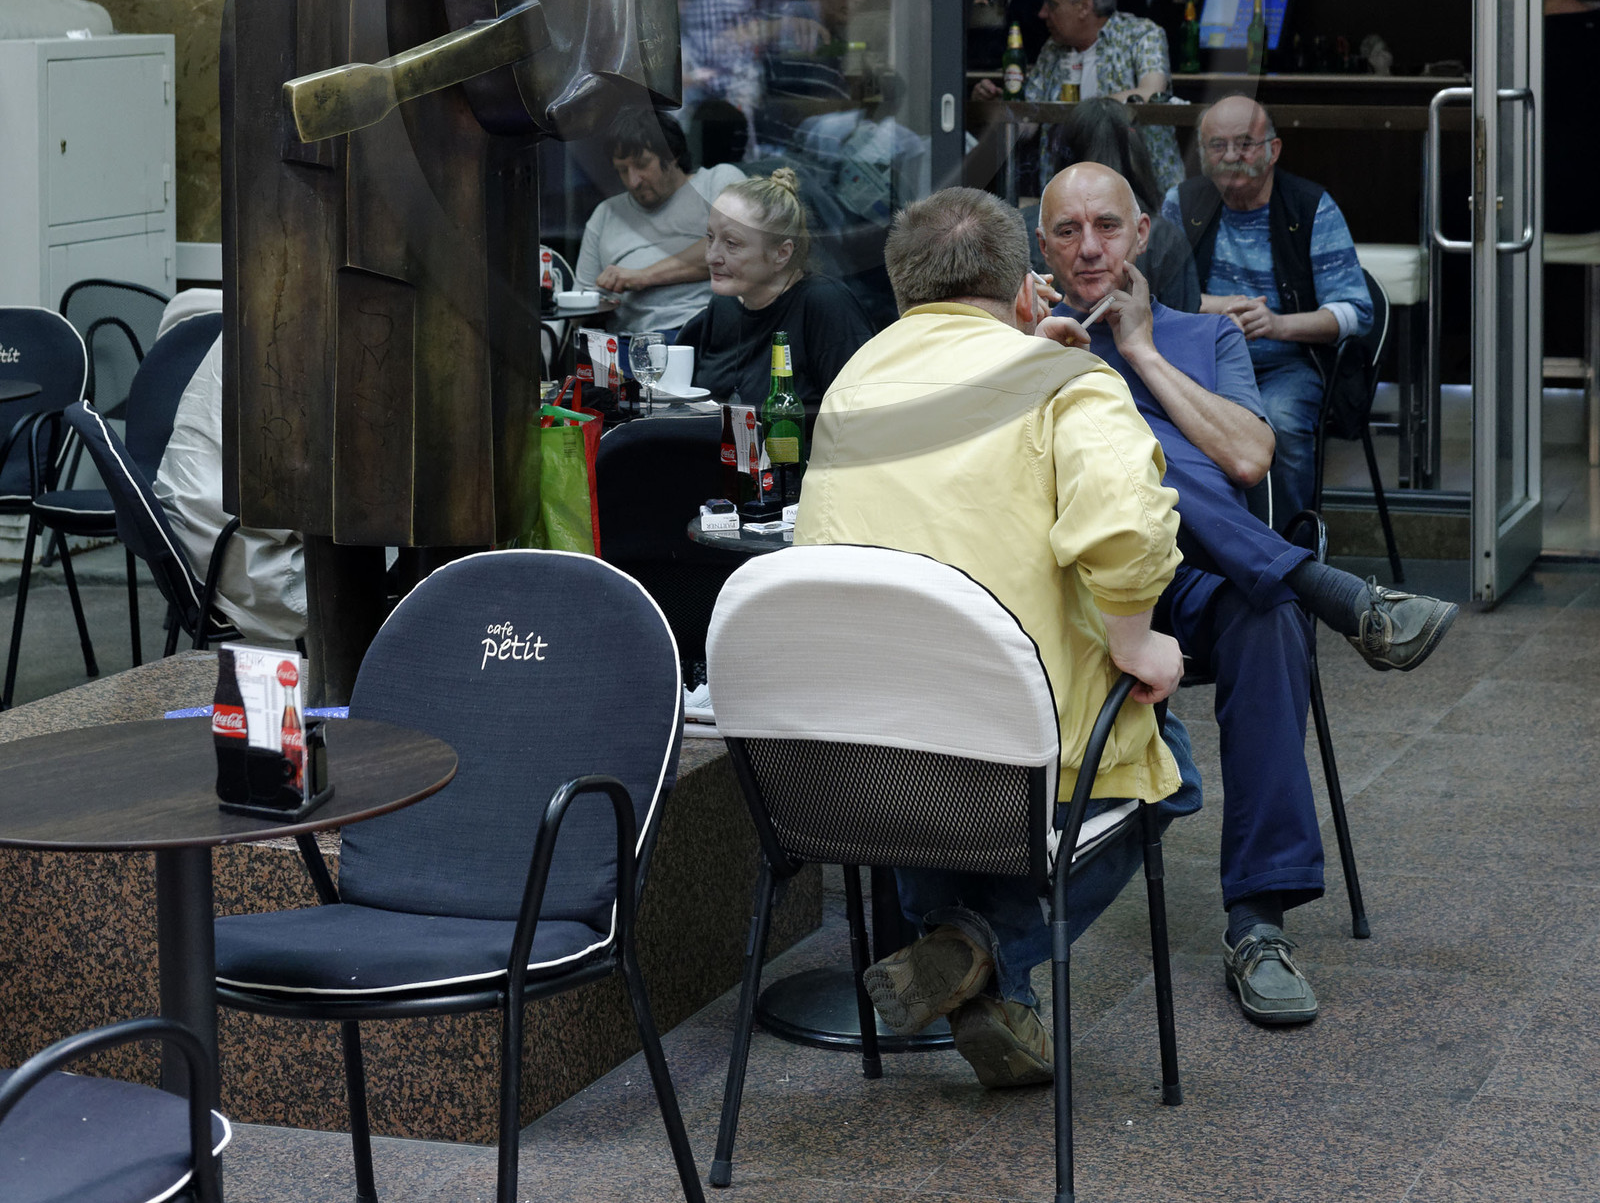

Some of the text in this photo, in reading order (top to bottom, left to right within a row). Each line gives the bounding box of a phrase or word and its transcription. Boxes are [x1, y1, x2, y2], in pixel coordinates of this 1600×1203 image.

[487, 621, 514, 640] cafe
[481, 632, 549, 671] petit
[212, 710, 244, 729] Coca-Cola
